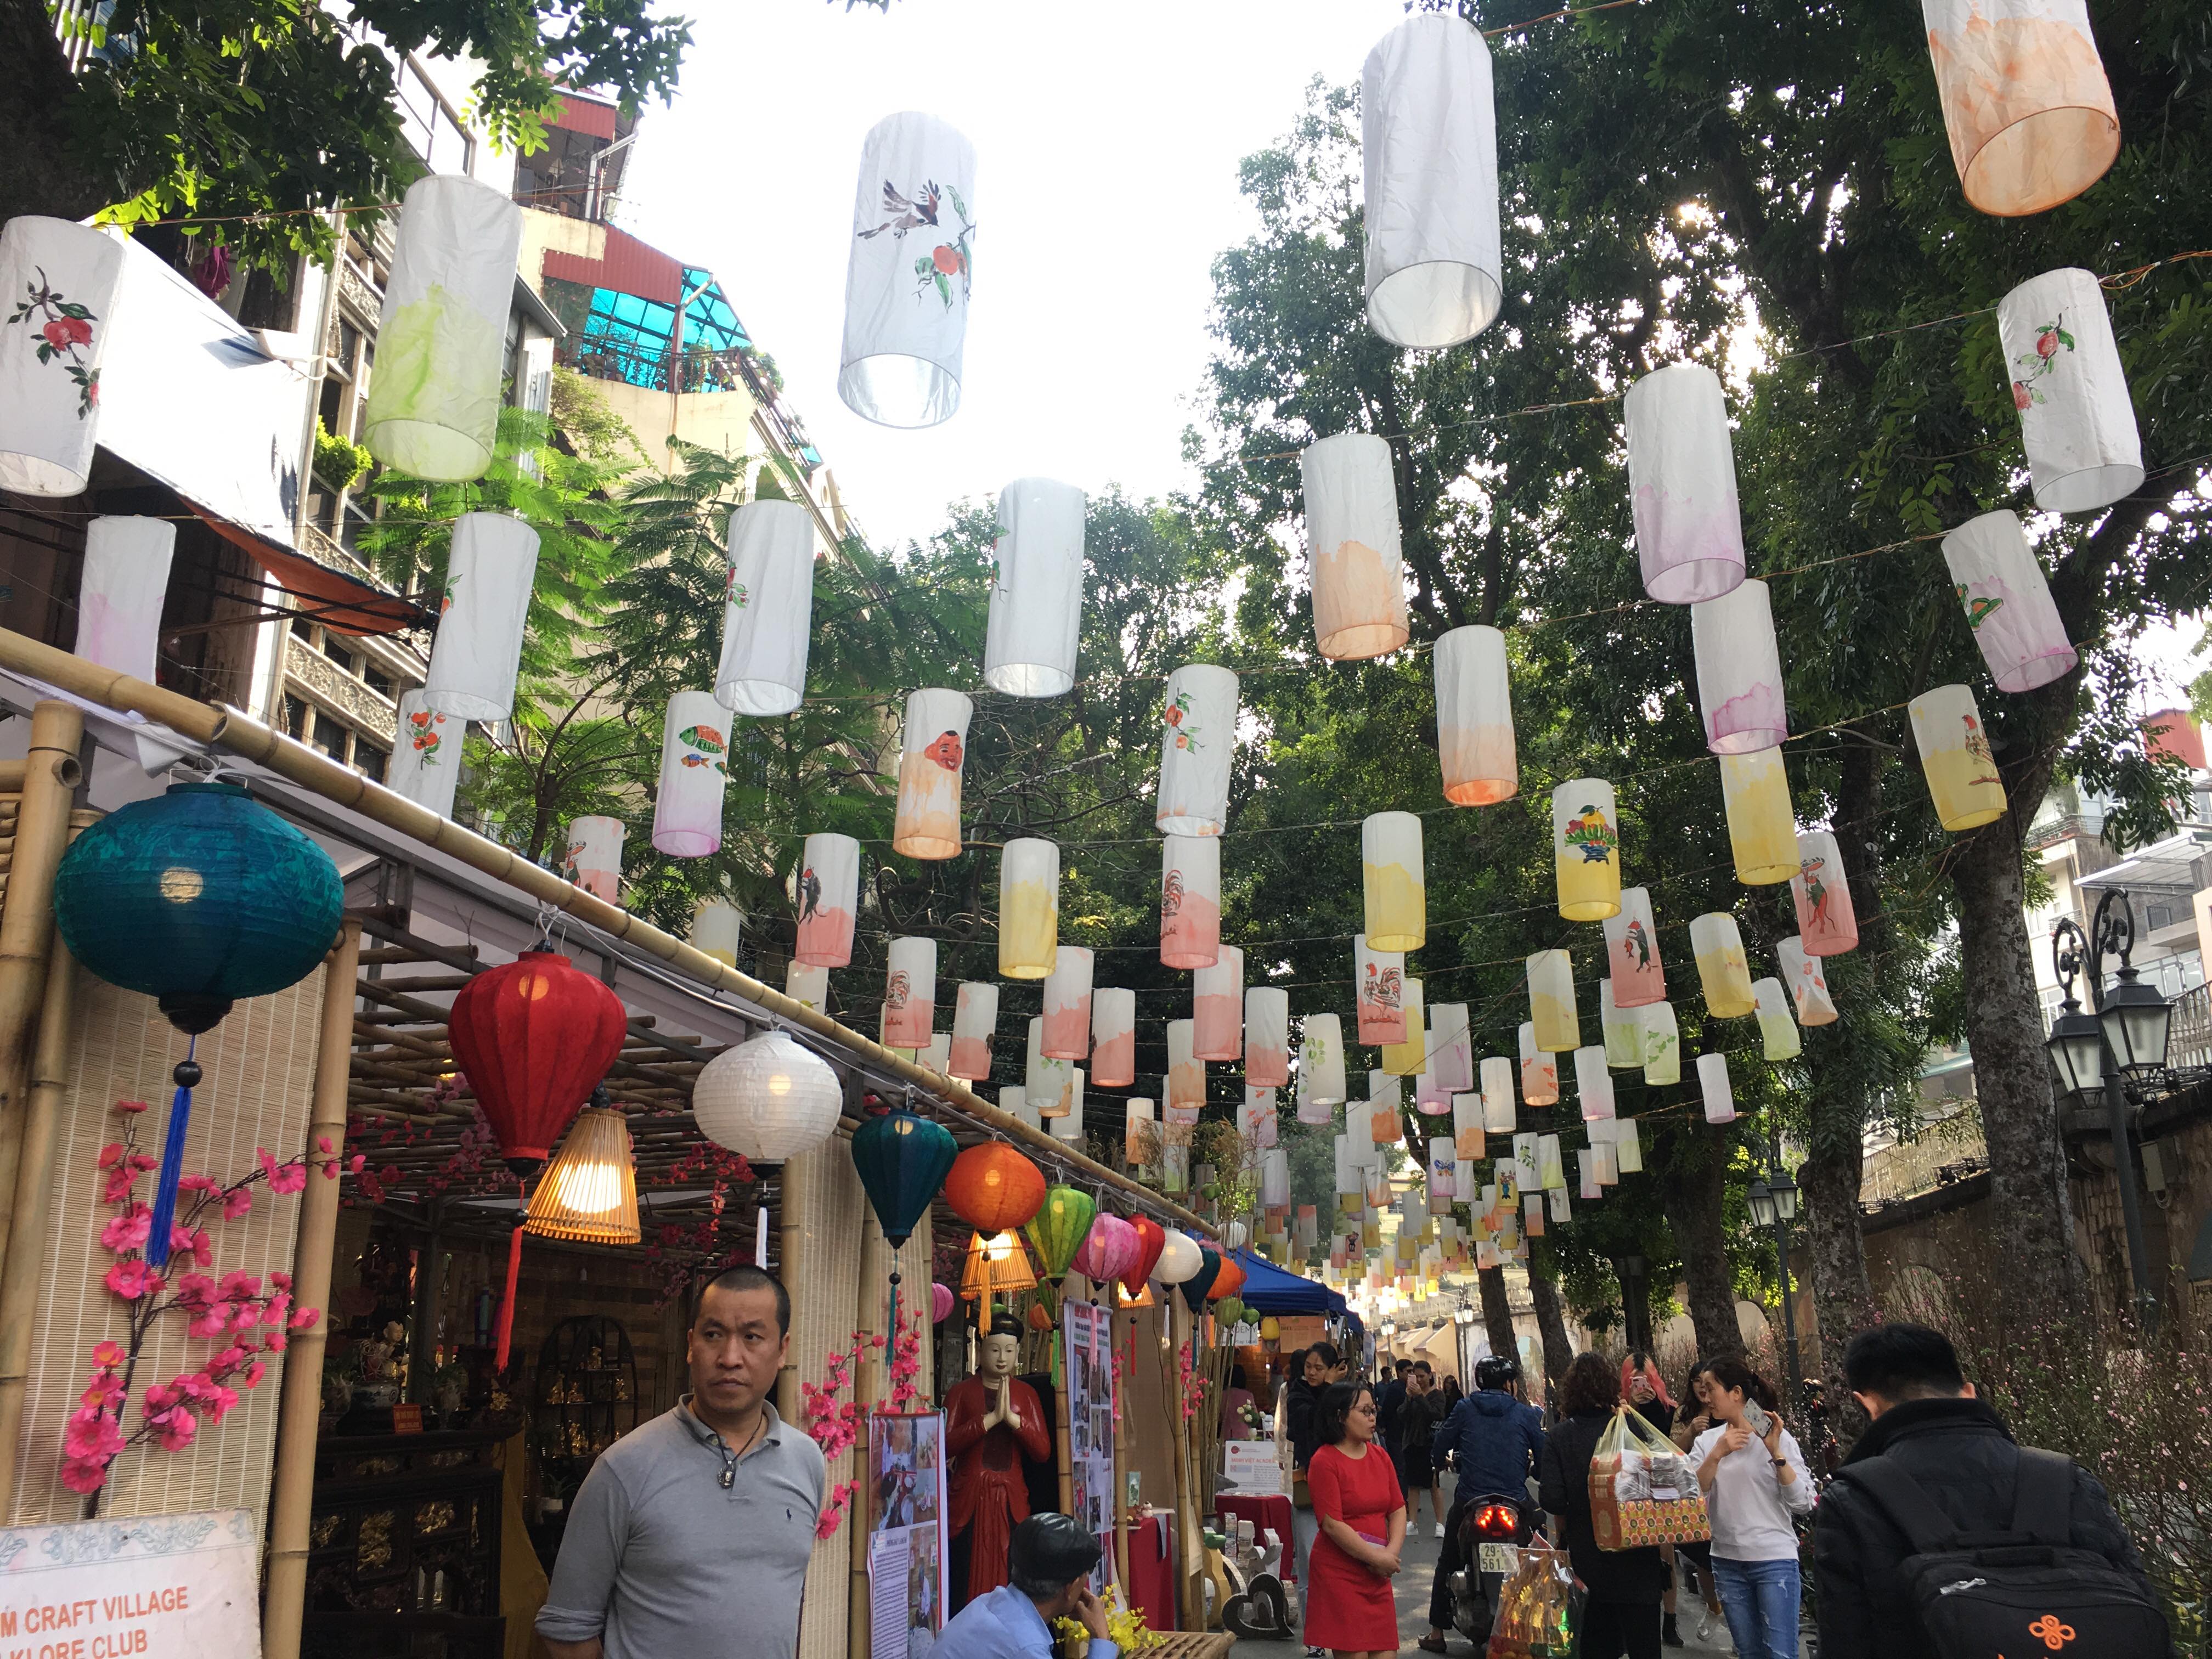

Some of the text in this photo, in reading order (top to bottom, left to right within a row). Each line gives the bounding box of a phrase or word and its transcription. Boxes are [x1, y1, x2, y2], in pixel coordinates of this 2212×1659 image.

[0, 1586, 188, 1638] M CRAFT VILLAGE
[92, 1628, 148, 1659] CLUB
